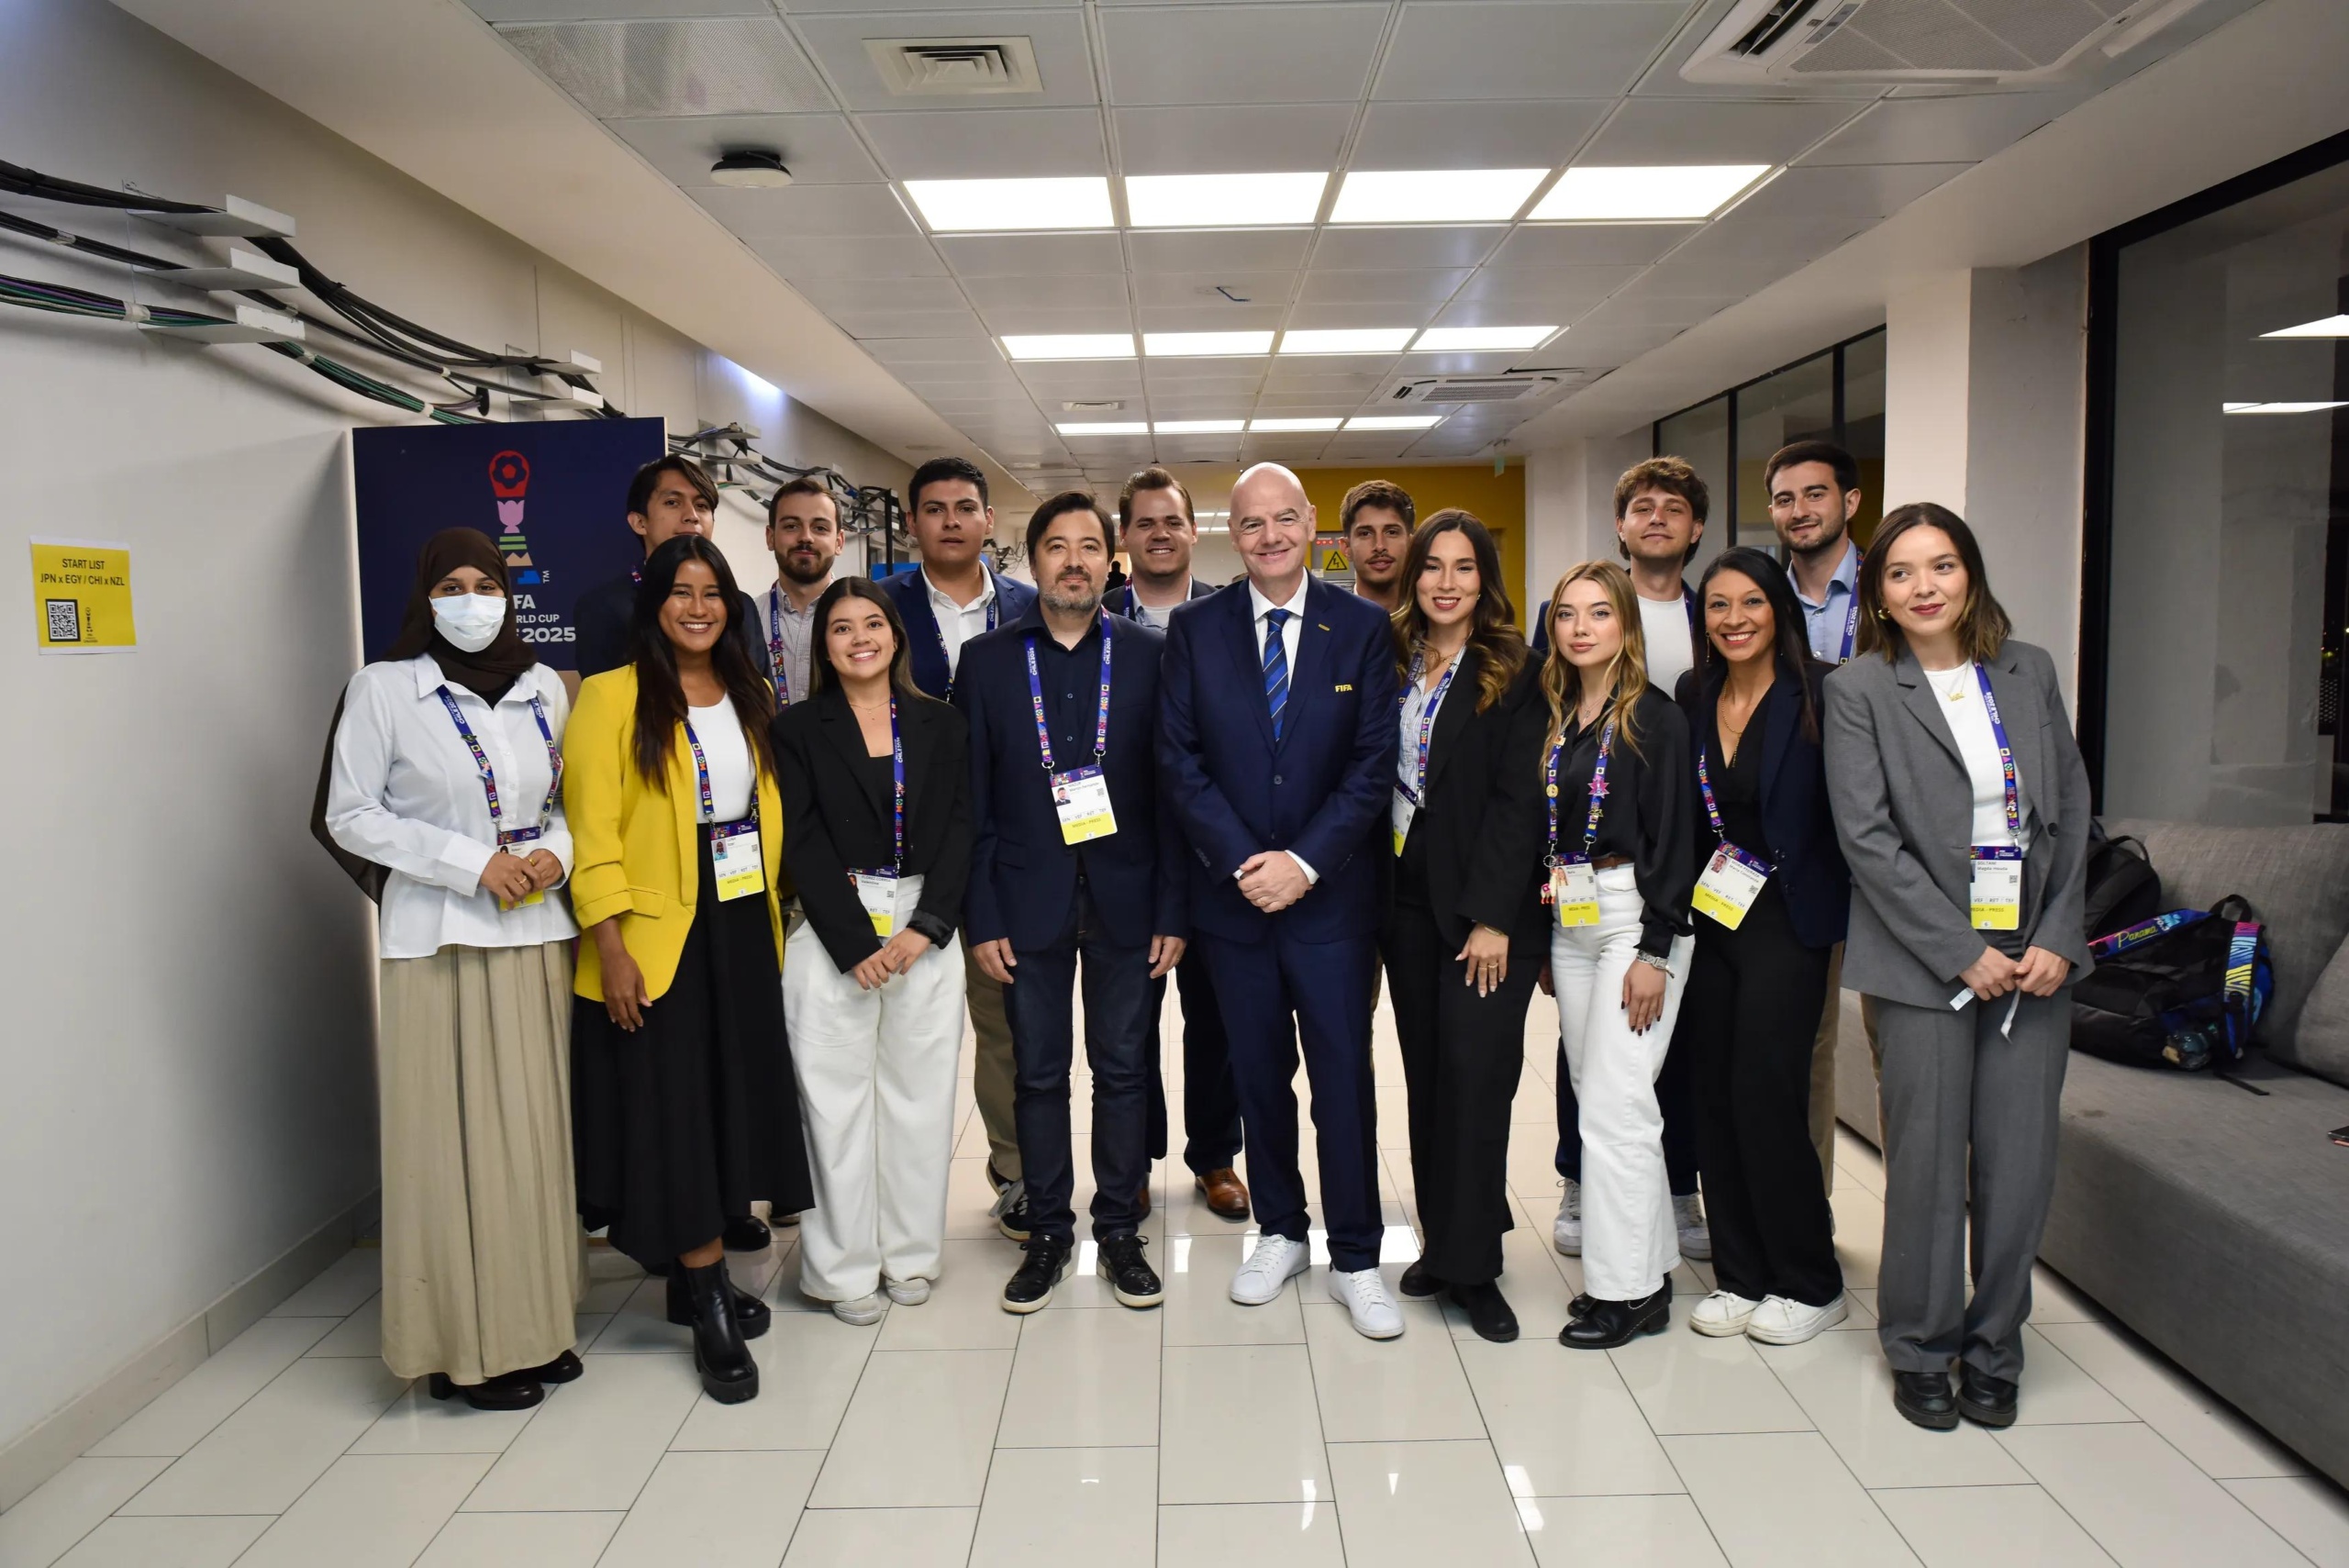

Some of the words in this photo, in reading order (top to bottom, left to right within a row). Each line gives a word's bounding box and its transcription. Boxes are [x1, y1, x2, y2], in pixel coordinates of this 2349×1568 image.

[62, 558, 87, 569] START
[89, 561, 105, 570] LIST
[40, 573, 56, 584] JPN
[66, 574, 82, 584] EGY
[88, 575, 103, 585] CHI
[110, 577, 125, 586] NZL
[513, 595, 536, 609] FA
[516, 615, 537, 624] RLD
[538, 614, 560, 623] CUP
[522, 627, 576, 642] 2025
[1334, 684, 1353, 693] FIFA
[1987, 692, 1995, 706] 2025
[454, 708, 464, 724] CHILE
[535, 703, 544, 718] CHILE
[1990, 707, 2000, 724] CHILE
[1604, 729, 1612, 745] CHILE
[2114, 926, 2158, 948] Panama
